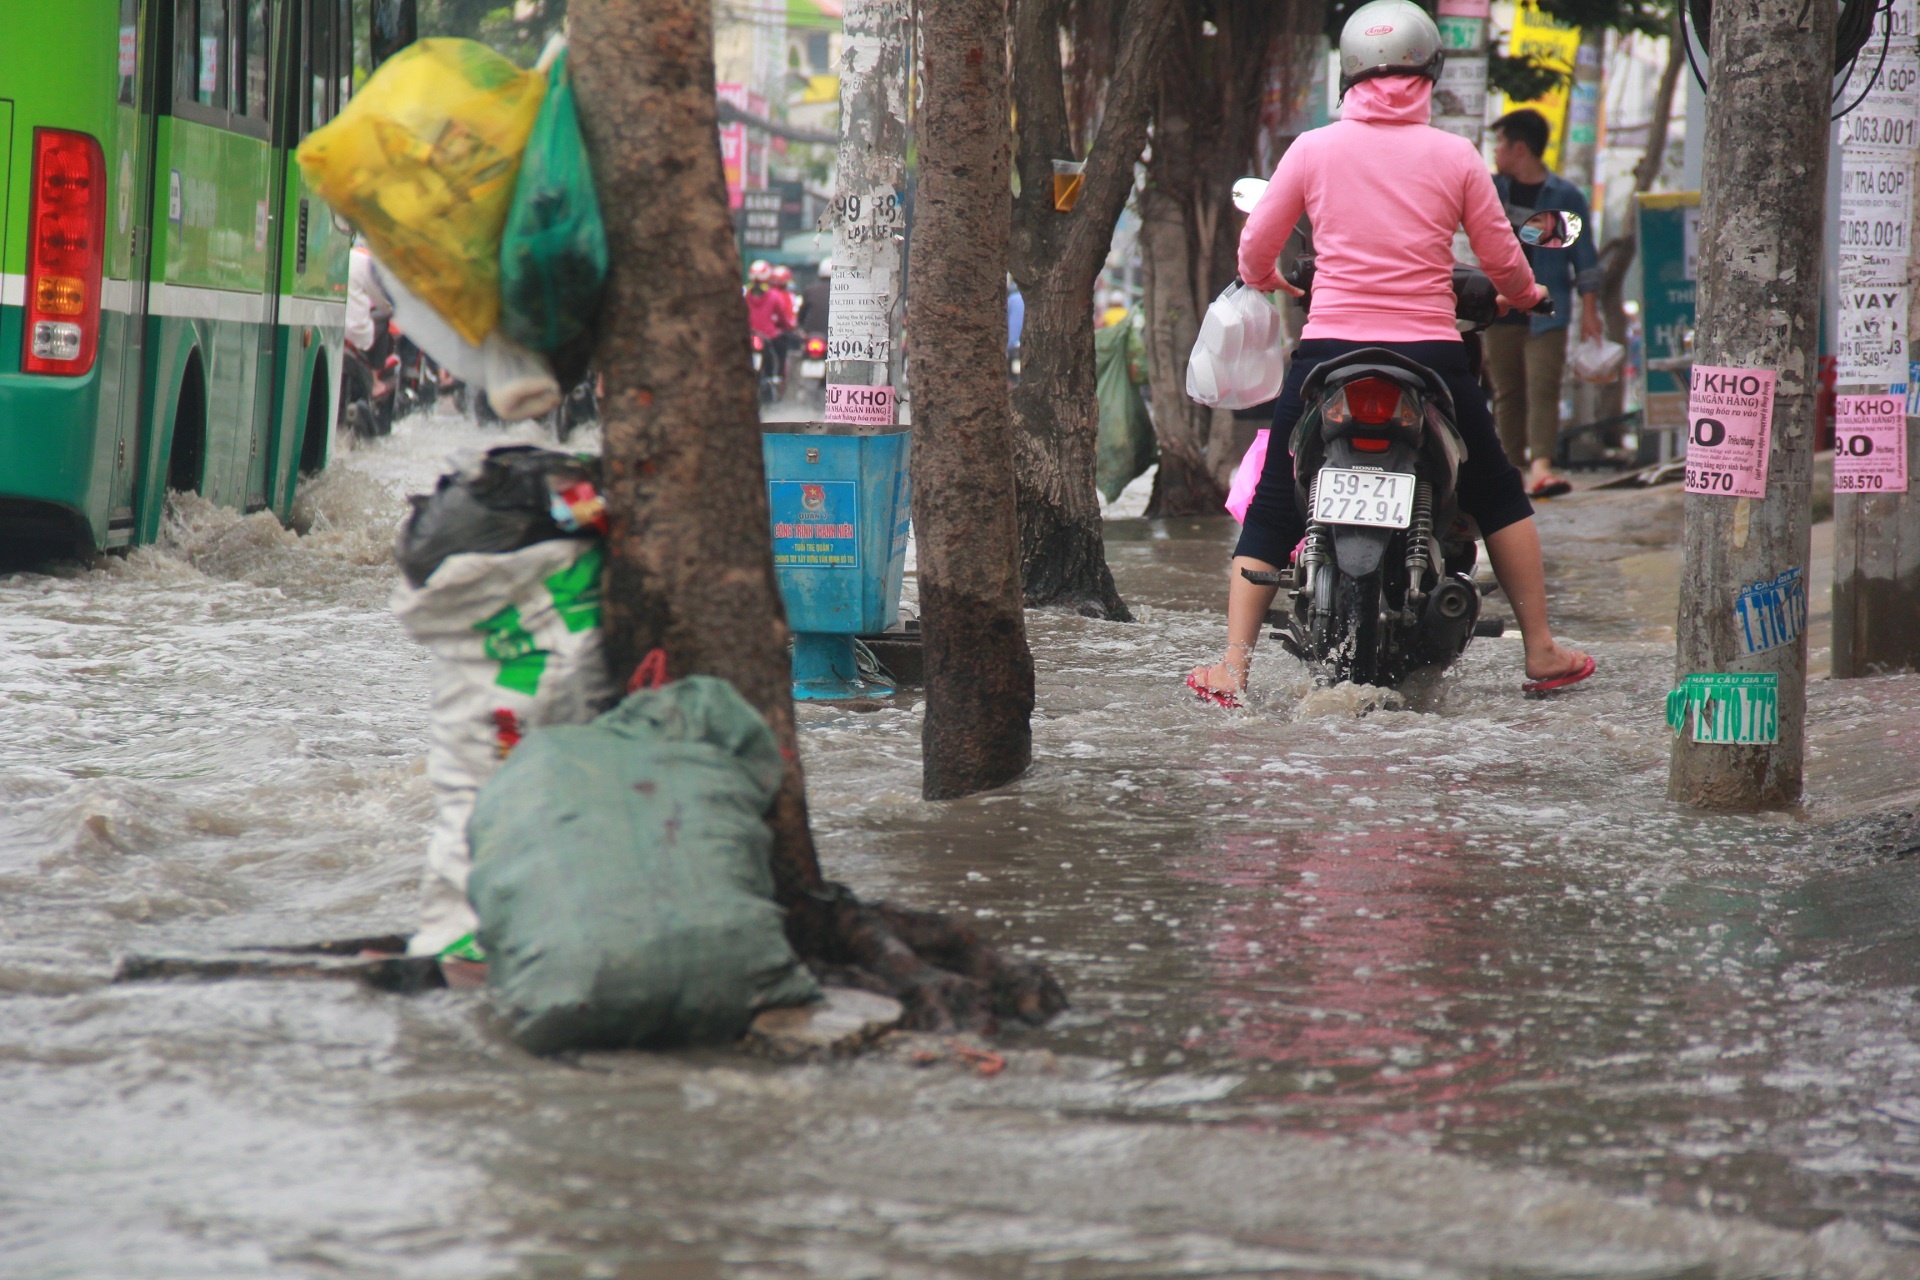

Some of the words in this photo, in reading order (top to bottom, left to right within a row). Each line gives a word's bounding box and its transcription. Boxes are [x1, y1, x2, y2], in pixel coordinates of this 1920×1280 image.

[1855, 165, 1875, 195] TRẢ
[1878, 165, 1905, 195] GÓP
[1854, 293, 1899, 309] VAY
[1704, 373, 1760, 396] KHO
[847, 390, 887, 406] KHO
[1726, 394, 1759, 409] HÀNG)
[1854, 400, 1895, 415] KHO
[1320, 496, 1404, 524] 272.94
